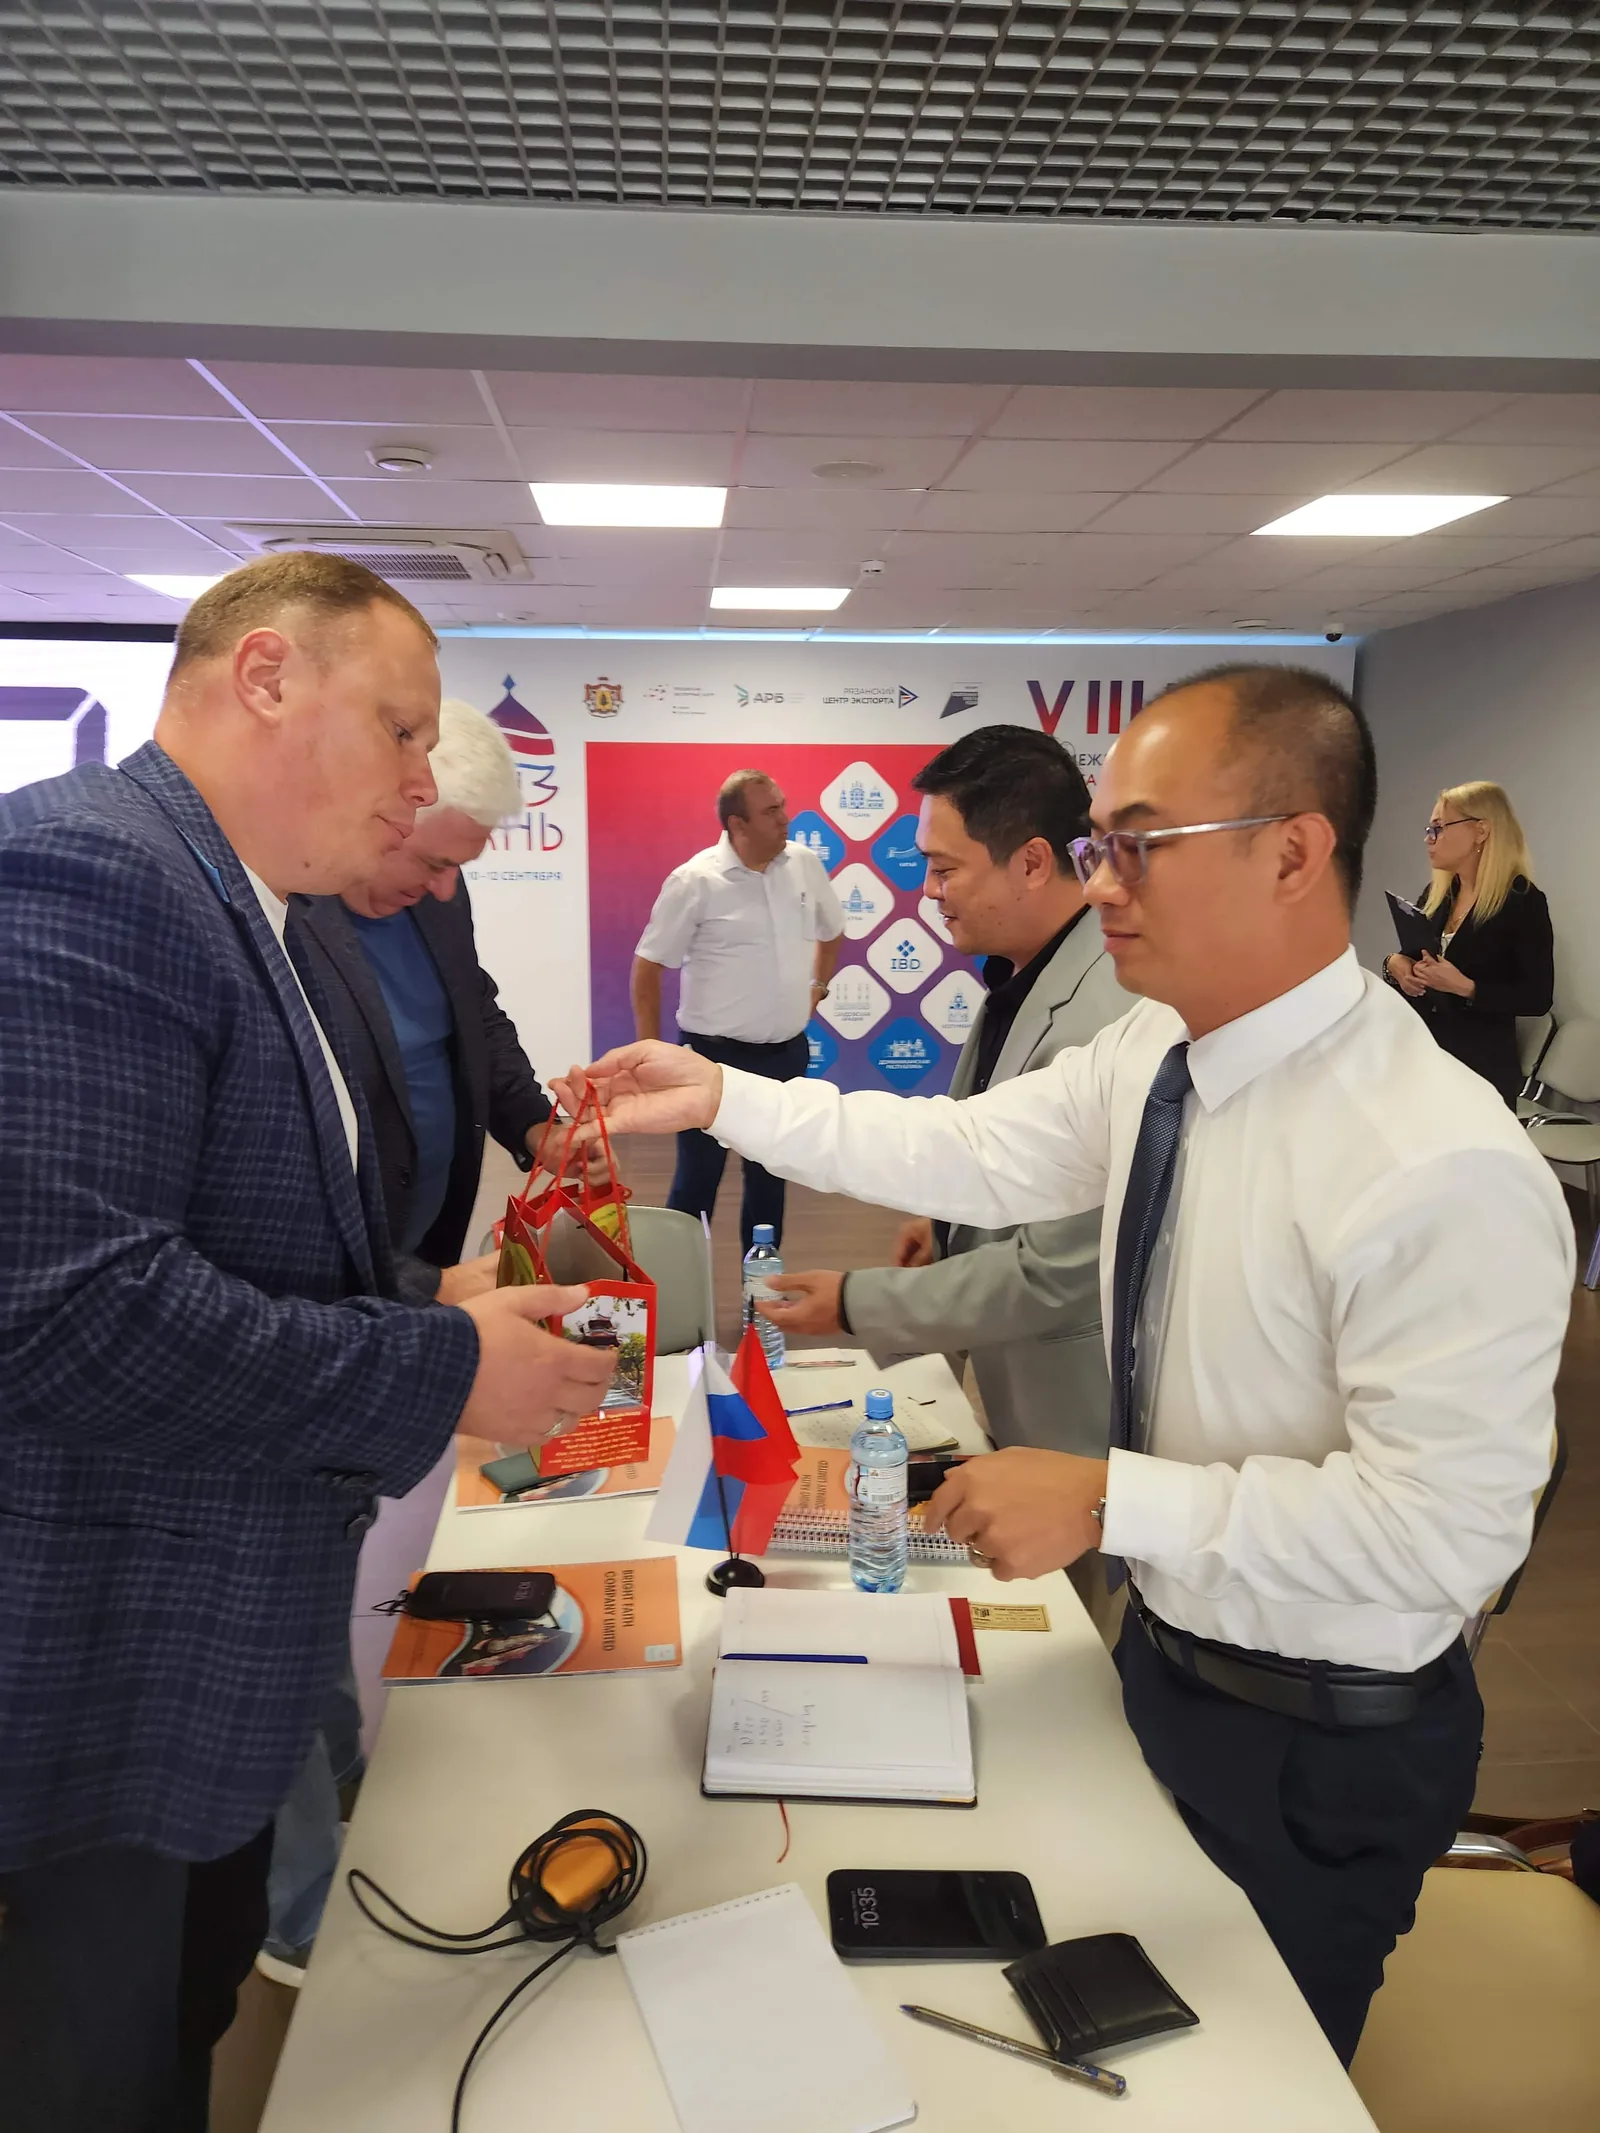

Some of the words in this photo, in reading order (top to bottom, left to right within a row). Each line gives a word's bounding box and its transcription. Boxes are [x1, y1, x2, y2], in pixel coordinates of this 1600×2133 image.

[822, 697, 849, 705] ЦЕНТР
[851, 697, 895, 705] ЭКСПОРТА
[890, 958, 921, 970] IBD
[603, 1571, 617, 1616] COMPANY
[621, 1569, 635, 1601] BRIGHT
[621, 1603, 635, 1628] FAITH
[602, 1618, 616, 1652] LIMITED
[857, 1887, 880, 1930] 10:35
